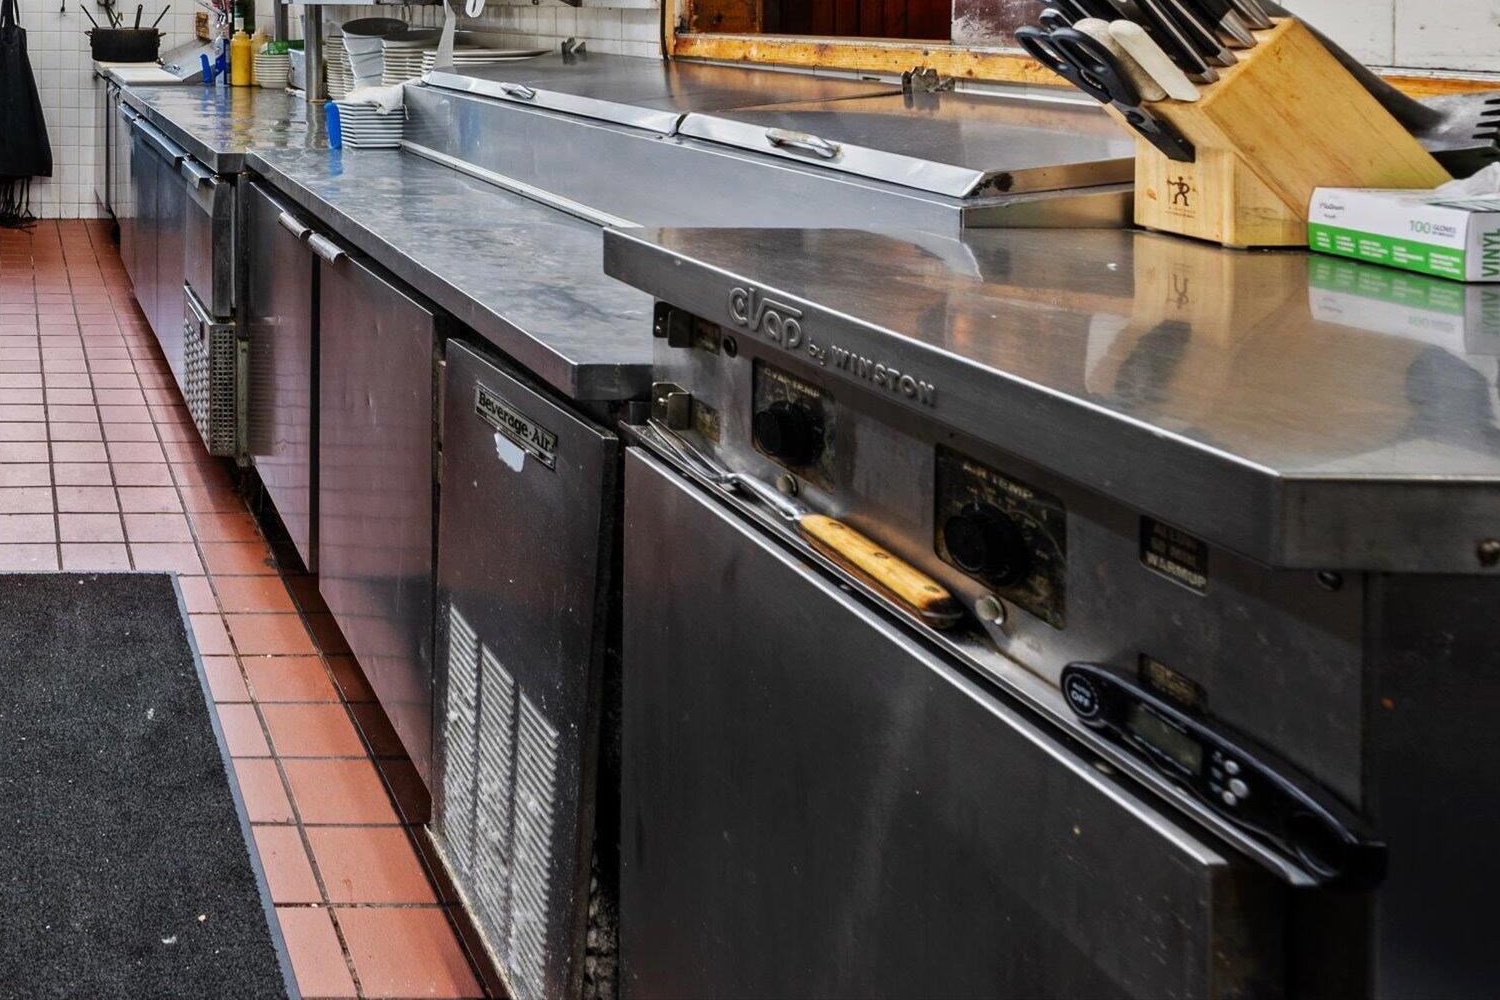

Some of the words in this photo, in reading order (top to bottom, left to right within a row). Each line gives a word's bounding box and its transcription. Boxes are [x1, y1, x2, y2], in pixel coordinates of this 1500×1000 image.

[1409, 220, 1431, 234] 100
[831, 345, 937, 408] WINSTON
[1145, 550, 1206, 586] WARMUP
